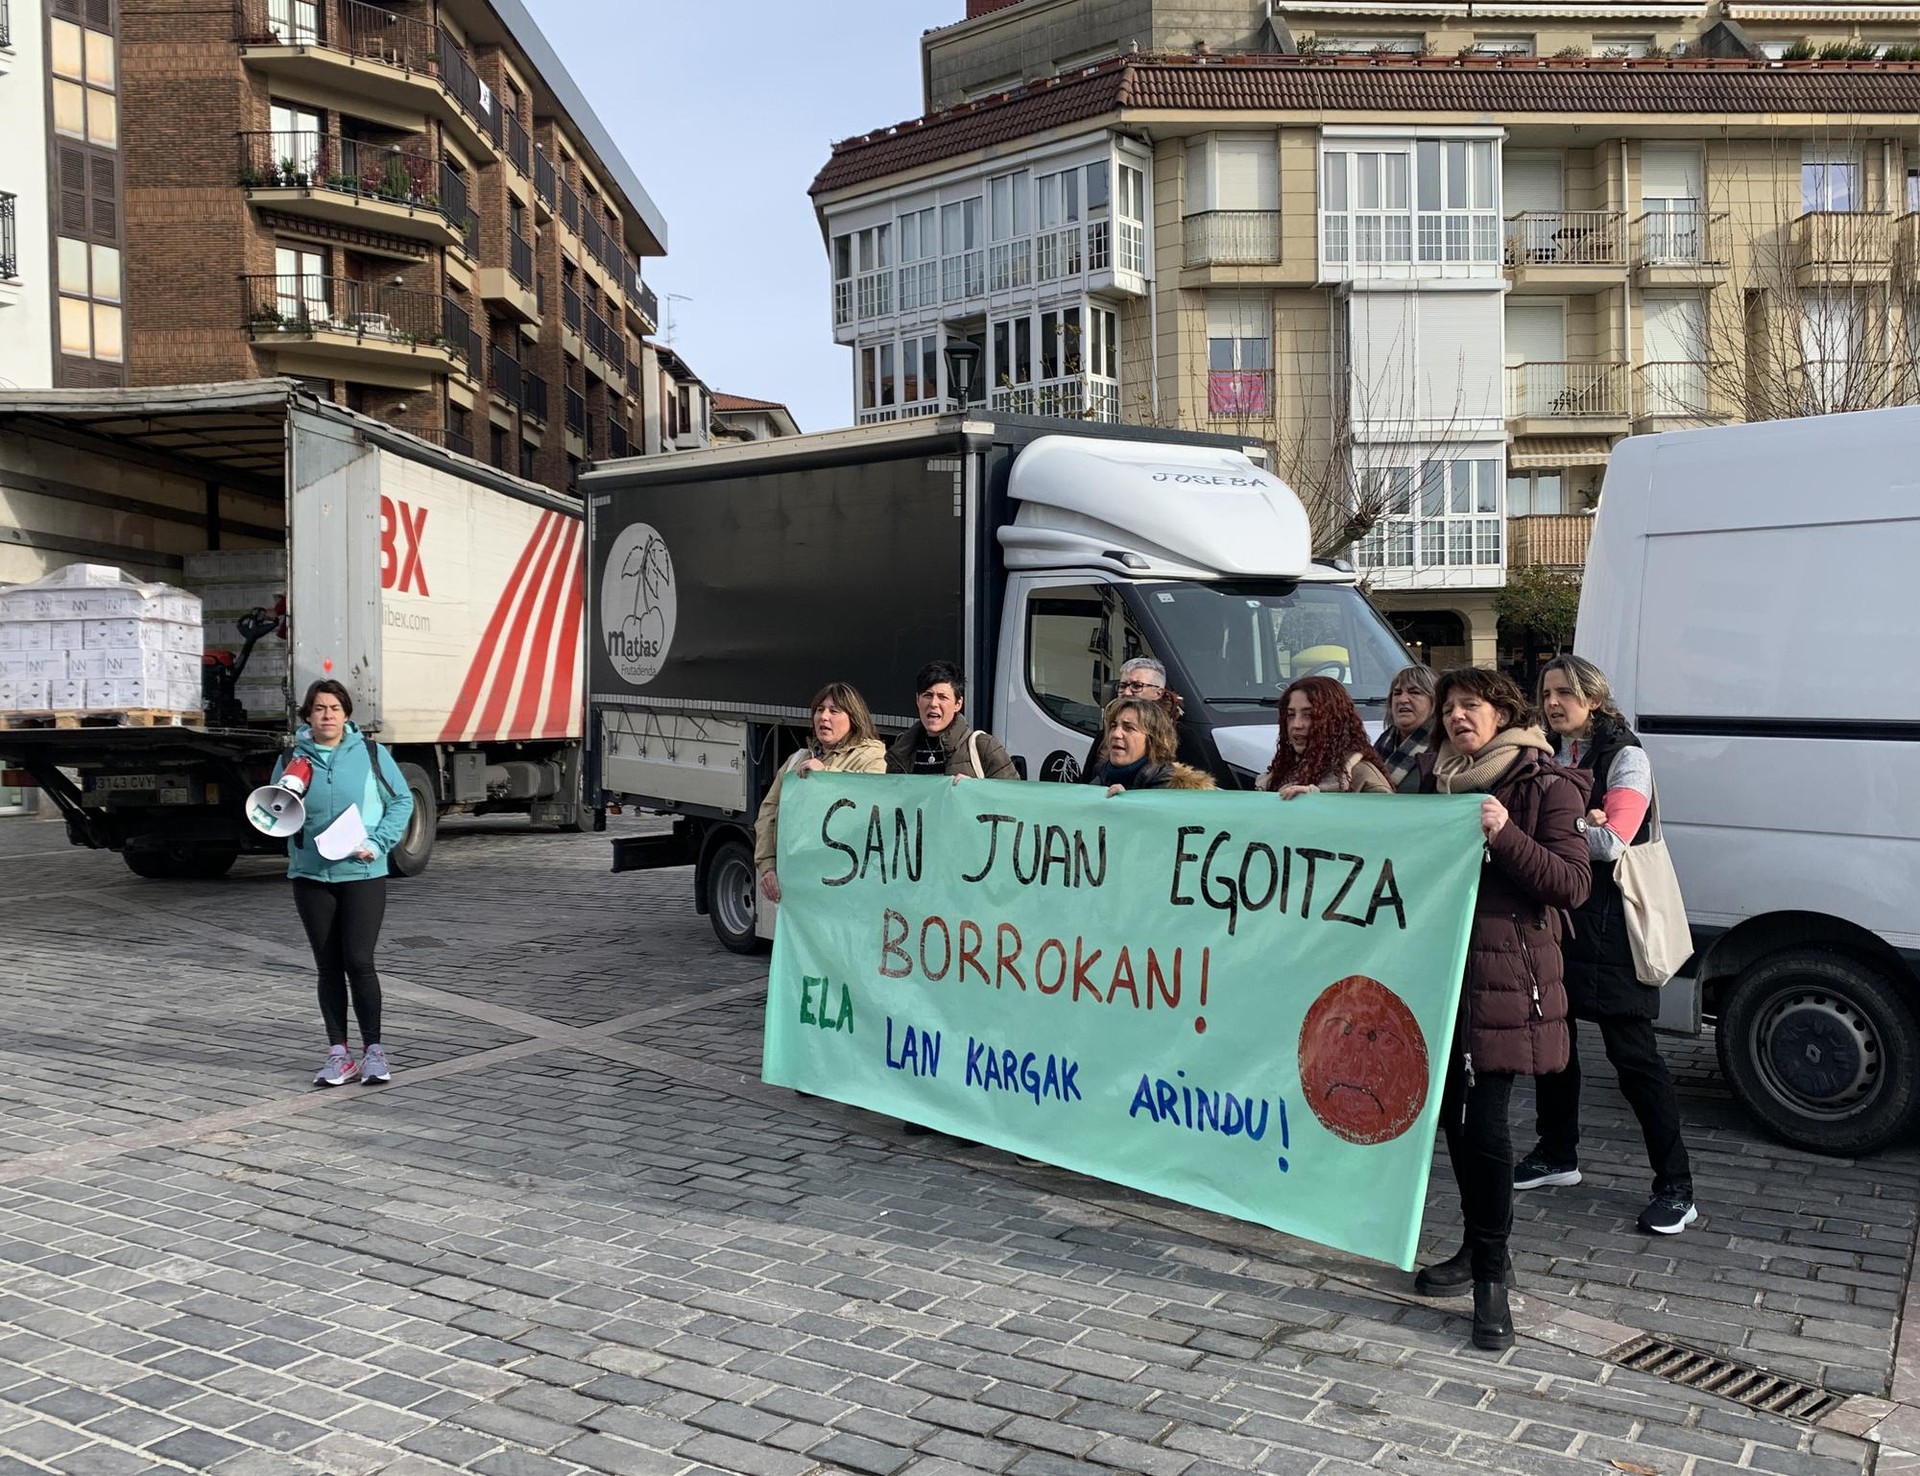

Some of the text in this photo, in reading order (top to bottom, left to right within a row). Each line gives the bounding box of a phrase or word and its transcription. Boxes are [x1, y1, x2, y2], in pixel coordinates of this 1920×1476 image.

[1152, 472, 1268, 488] JOSEBA
[822, 799, 1407, 937] SAN JUAN EGOITZA
[799, 976, 855, 1034] ELA
[878, 907, 1210, 1035] BORROKAN!
[886, 1016, 942, 1078] LAN
[965, 1036, 1082, 1106] KARGAK
